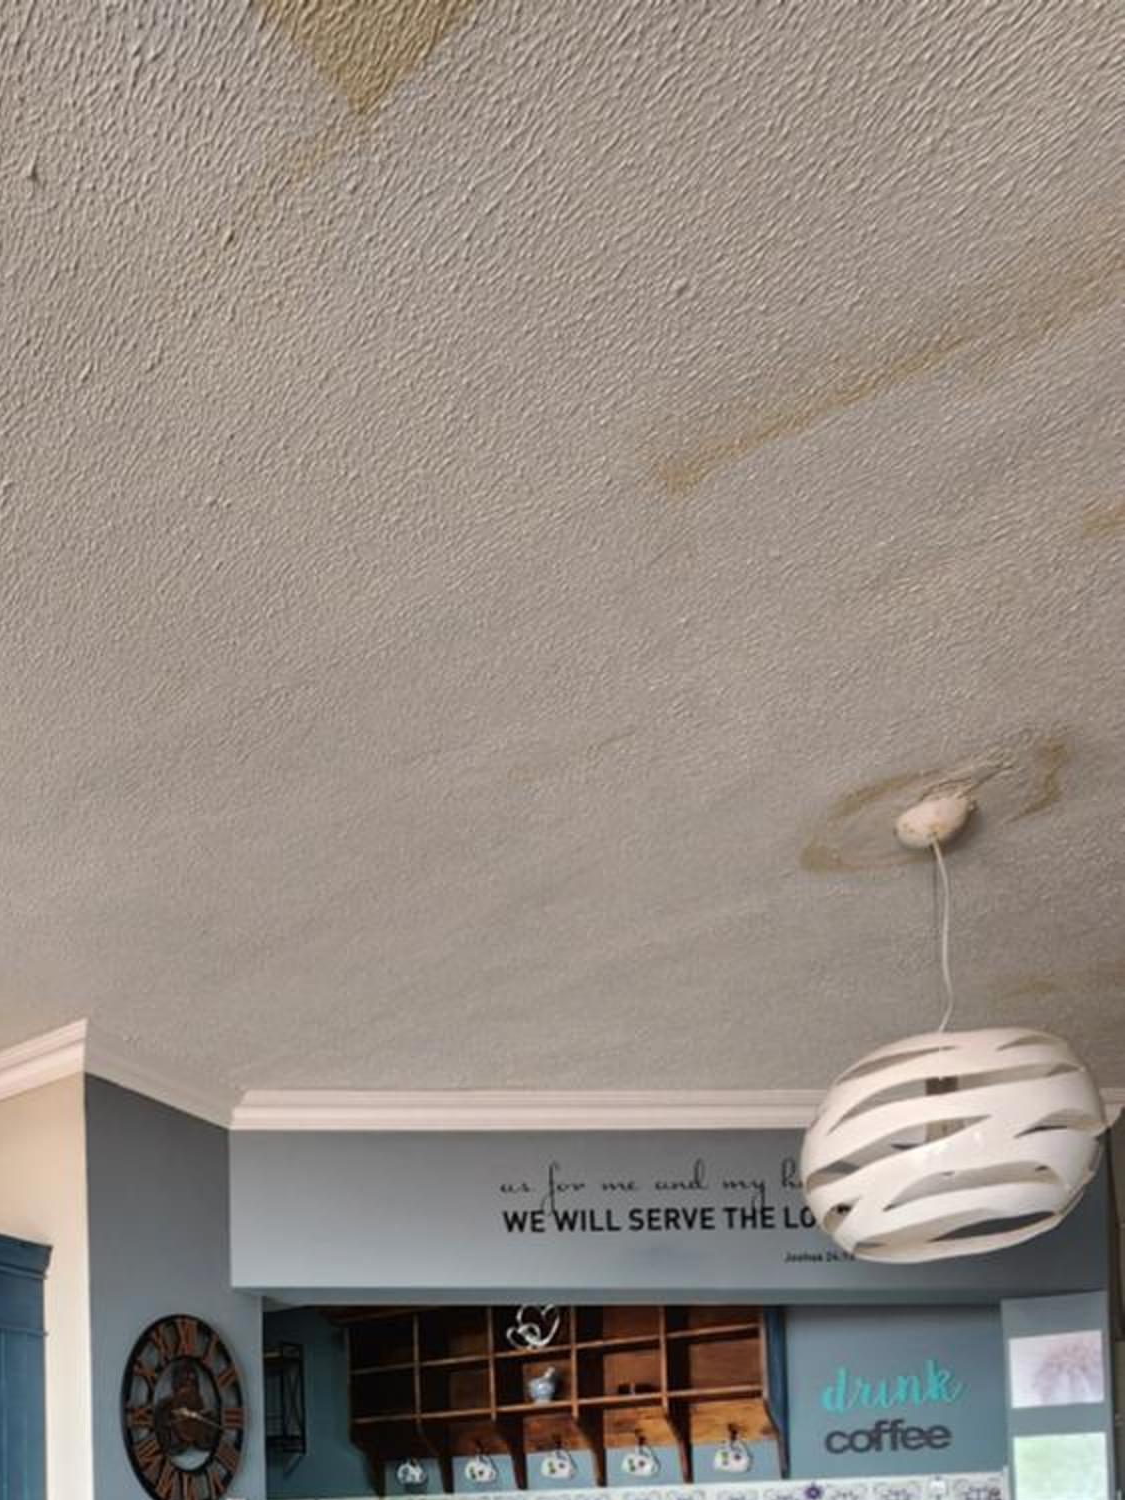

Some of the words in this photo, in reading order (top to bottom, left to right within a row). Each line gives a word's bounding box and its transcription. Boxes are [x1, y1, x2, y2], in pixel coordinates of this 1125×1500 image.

[500, 1182, 531, 1193] as
[539, 1161, 586, 1216] for
[602, 1181, 637, 1191] me
[655, 1158, 707, 1190] and
[722, 1180, 765, 1213] my
[503, 1209, 545, 1233] WE
[553, 1208, 622, 1232] WILL
[628, 1207, 716, 1231] SERVE
[723, 1205, 775, 1230] THE
[783, 1205, 817, 1229] LO
[826, 1418, 952, 1455] coffee
